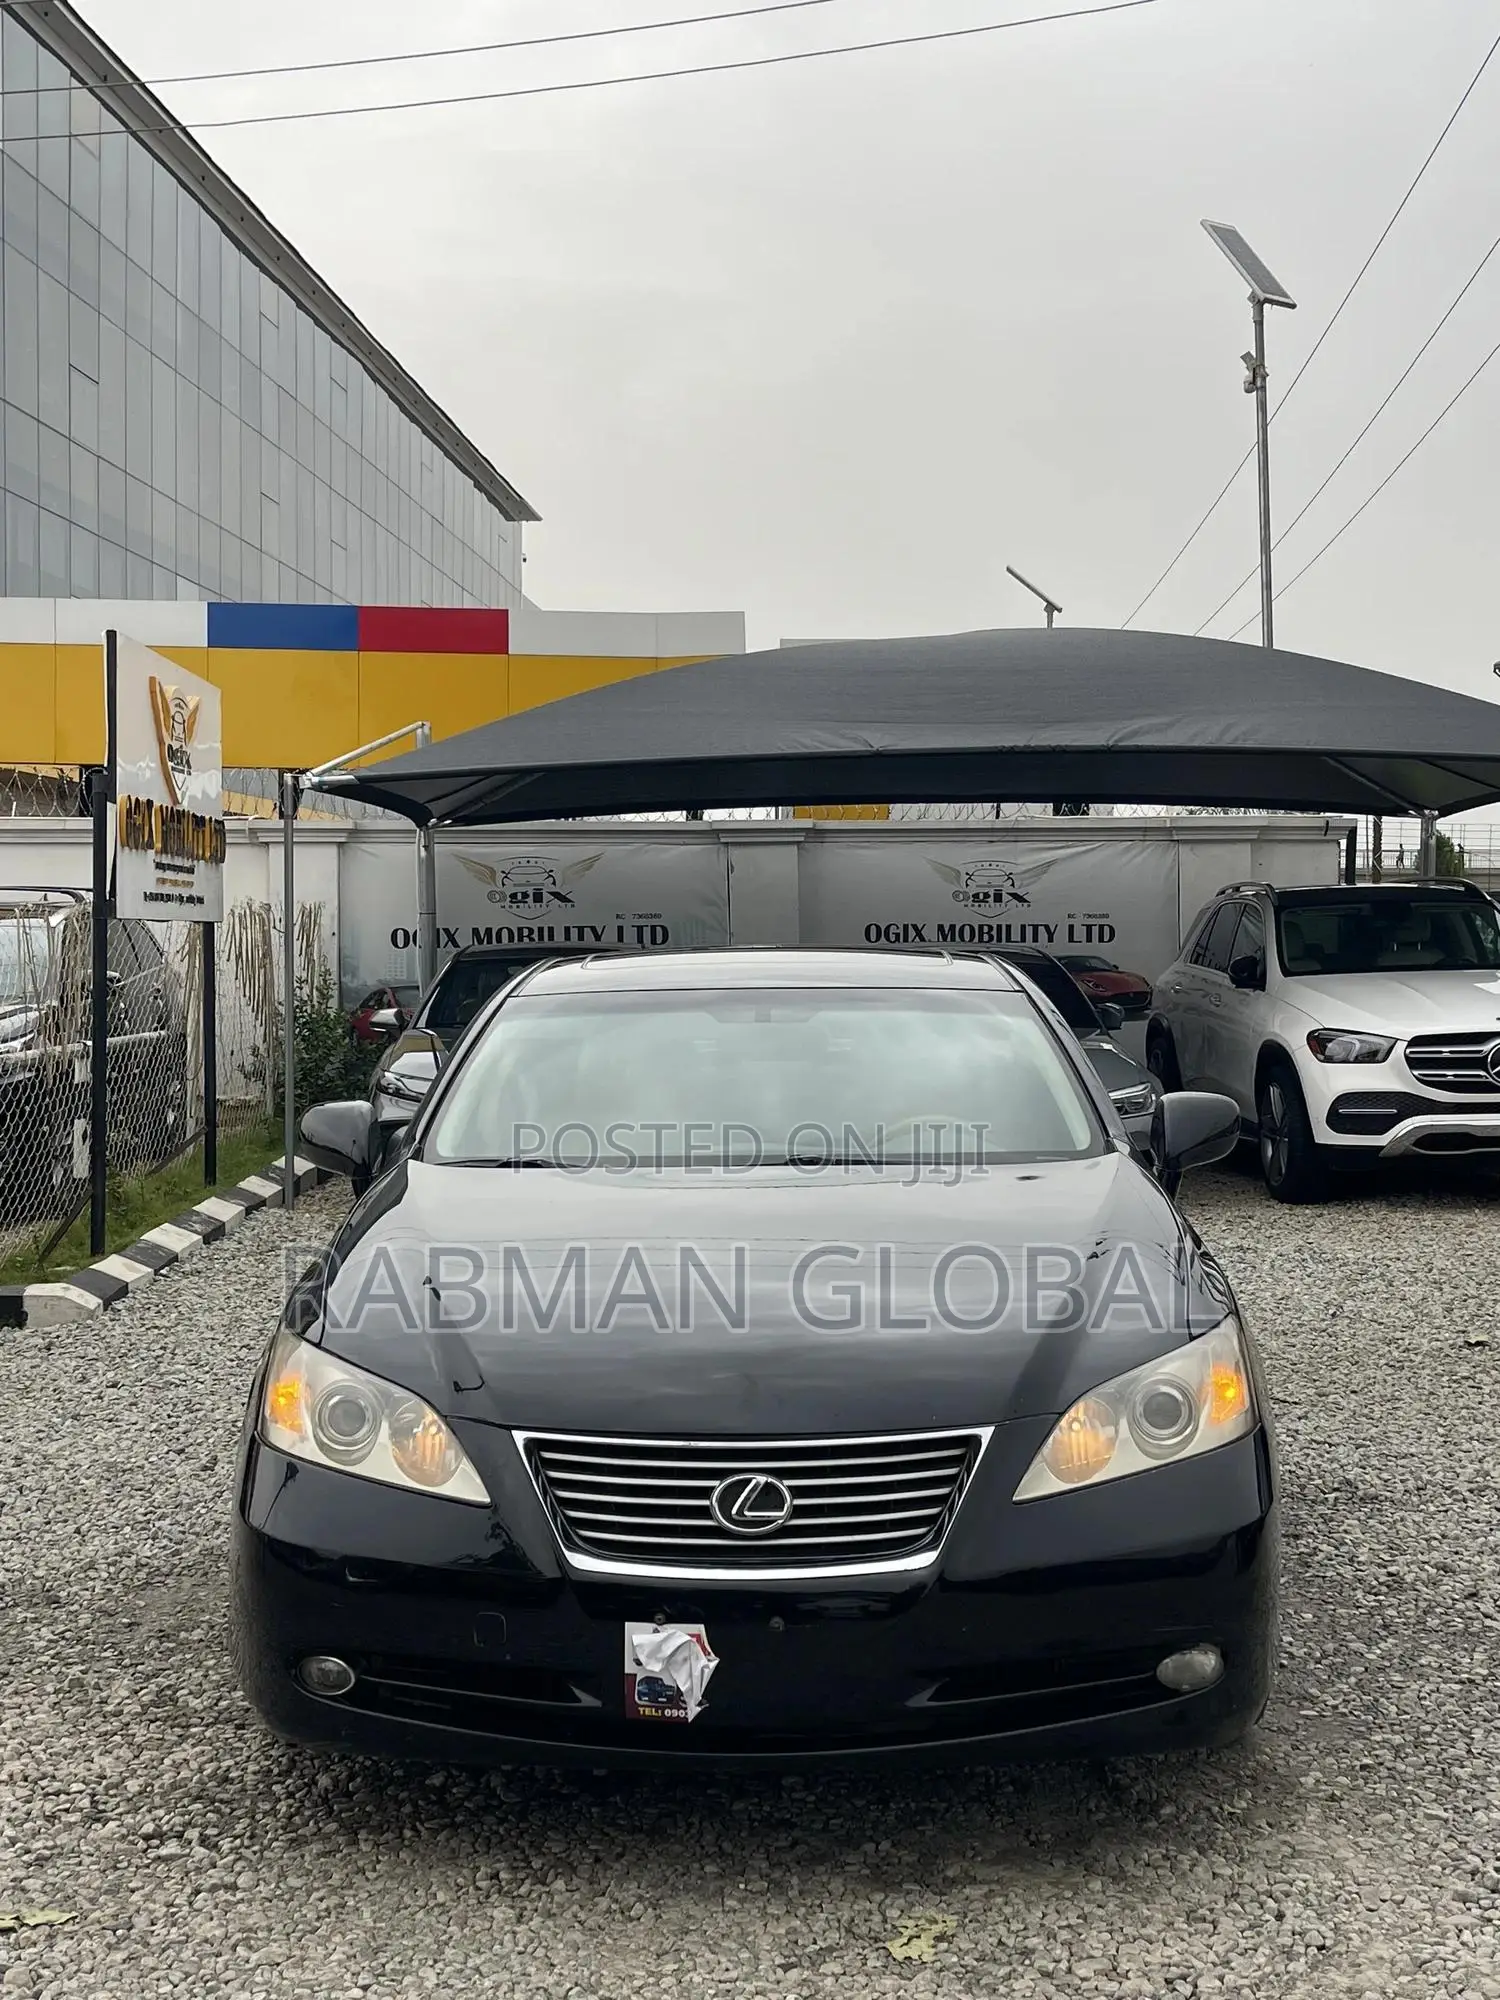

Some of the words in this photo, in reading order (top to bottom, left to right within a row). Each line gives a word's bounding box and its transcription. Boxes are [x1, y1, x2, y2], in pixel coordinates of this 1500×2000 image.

[864, 923, 928, 944] OGIX
[936, 923, 1059, 944] MOBILITY
[1067, 923, 1116, 944] LTD
[637, 1706, 662, 1717] TEL:
